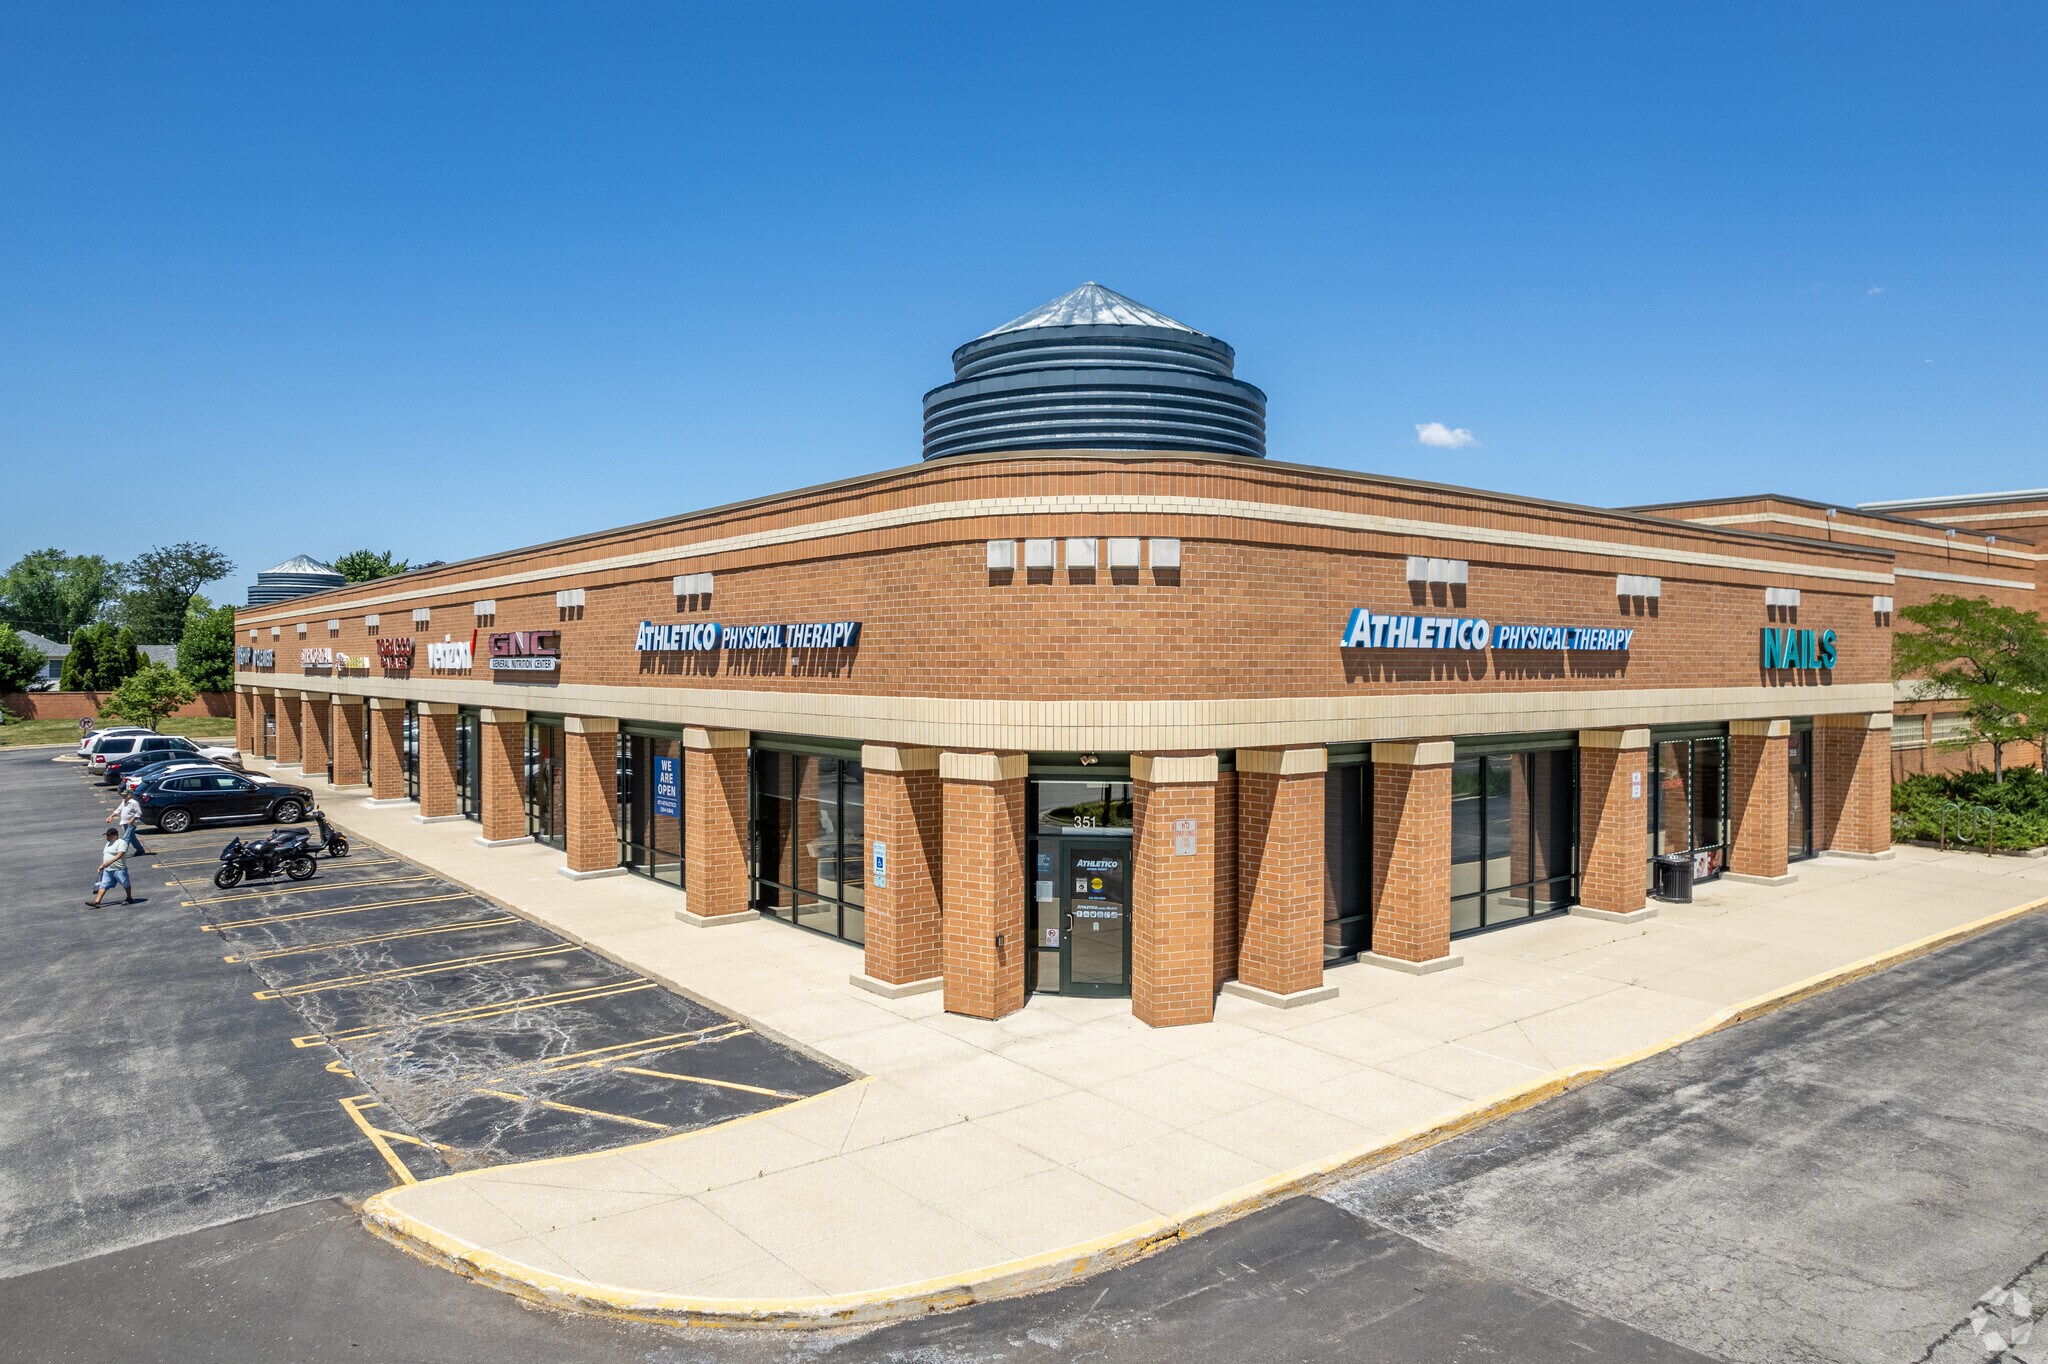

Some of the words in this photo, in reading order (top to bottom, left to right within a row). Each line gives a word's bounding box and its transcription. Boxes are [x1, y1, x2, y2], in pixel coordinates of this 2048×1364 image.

[635, 621, 719, 651] ATHLETICO
[721, 626, 786, 650] PHYSICAL
[785, 622, 858, 649] THERAPY
[1341, 608, 1490, 650] ATHLETICO
[1494, 625, 1570, 650] PHYSICAL
[1572, 627, 1634, 651] THERAPY
[376, 637, 416, 656] TOBACCO
[488, 631, 556, 656] GNC
[1760, 627, 1837, 670] NAILS
[427, 633, 473, 670] verizon
[380, 657, 409, 670] PALACE
[492, 659, 510, 668] GENERAL
[511, 659, 533, 669] NUTRITION
[534, 659, 551, 669] CENTER
[661, 759, 672, 771] WE
[660, 772, 674, 784] ARE
[657, 783, 676, 797] OPEN
[1073, 815, 1096, 829] 351
[1181, 821, 1190, 830] NO
[1076, 859, 1118, 868] ATHLETICO
